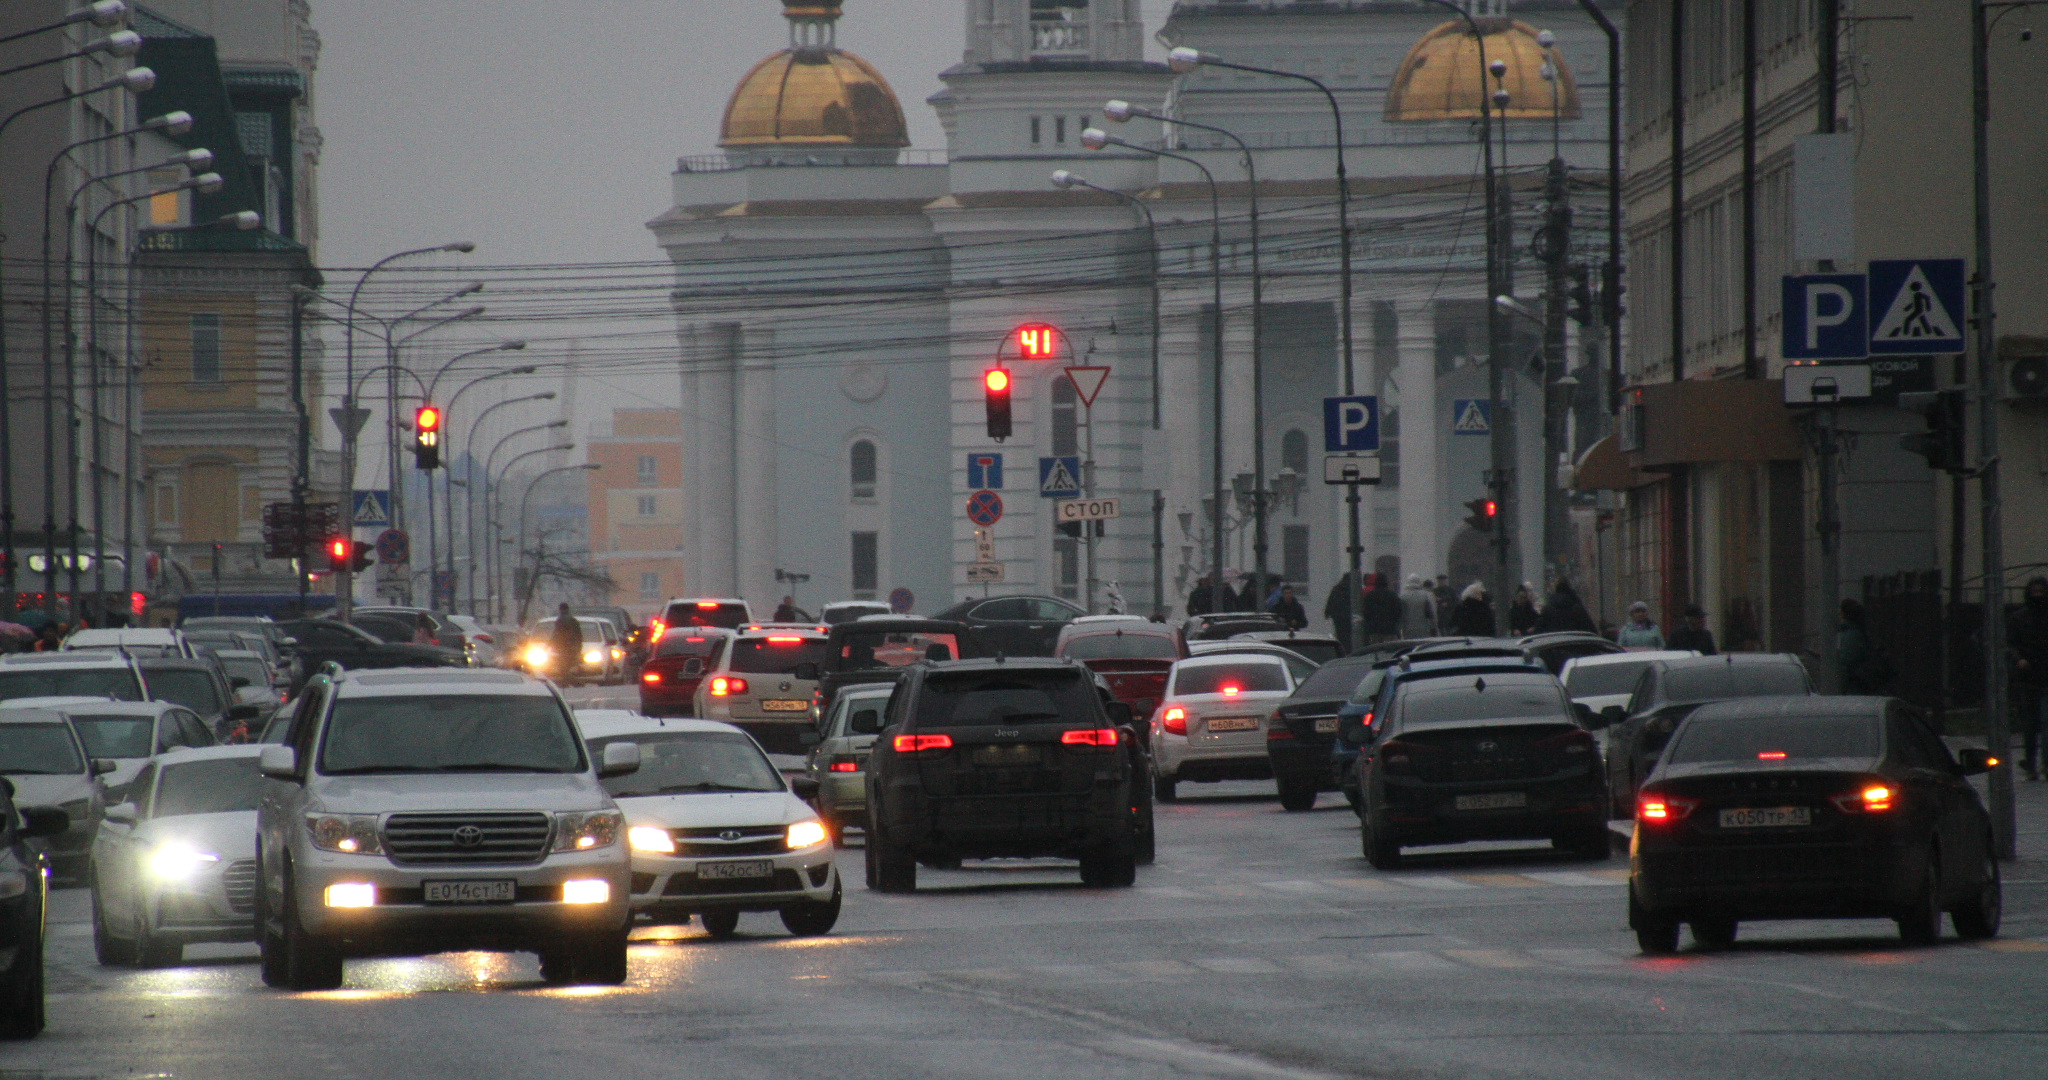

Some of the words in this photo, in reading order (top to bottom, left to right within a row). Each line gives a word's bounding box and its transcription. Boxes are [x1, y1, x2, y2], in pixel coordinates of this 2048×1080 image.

[1806, 283, 1853, 349] P
[1021, 330, 1050, 355] 41
[1339, 401, 1370, 445] P
[1064, 501, 1114, 518] СТОП
[994, 728, 1019, 738] Jeep
